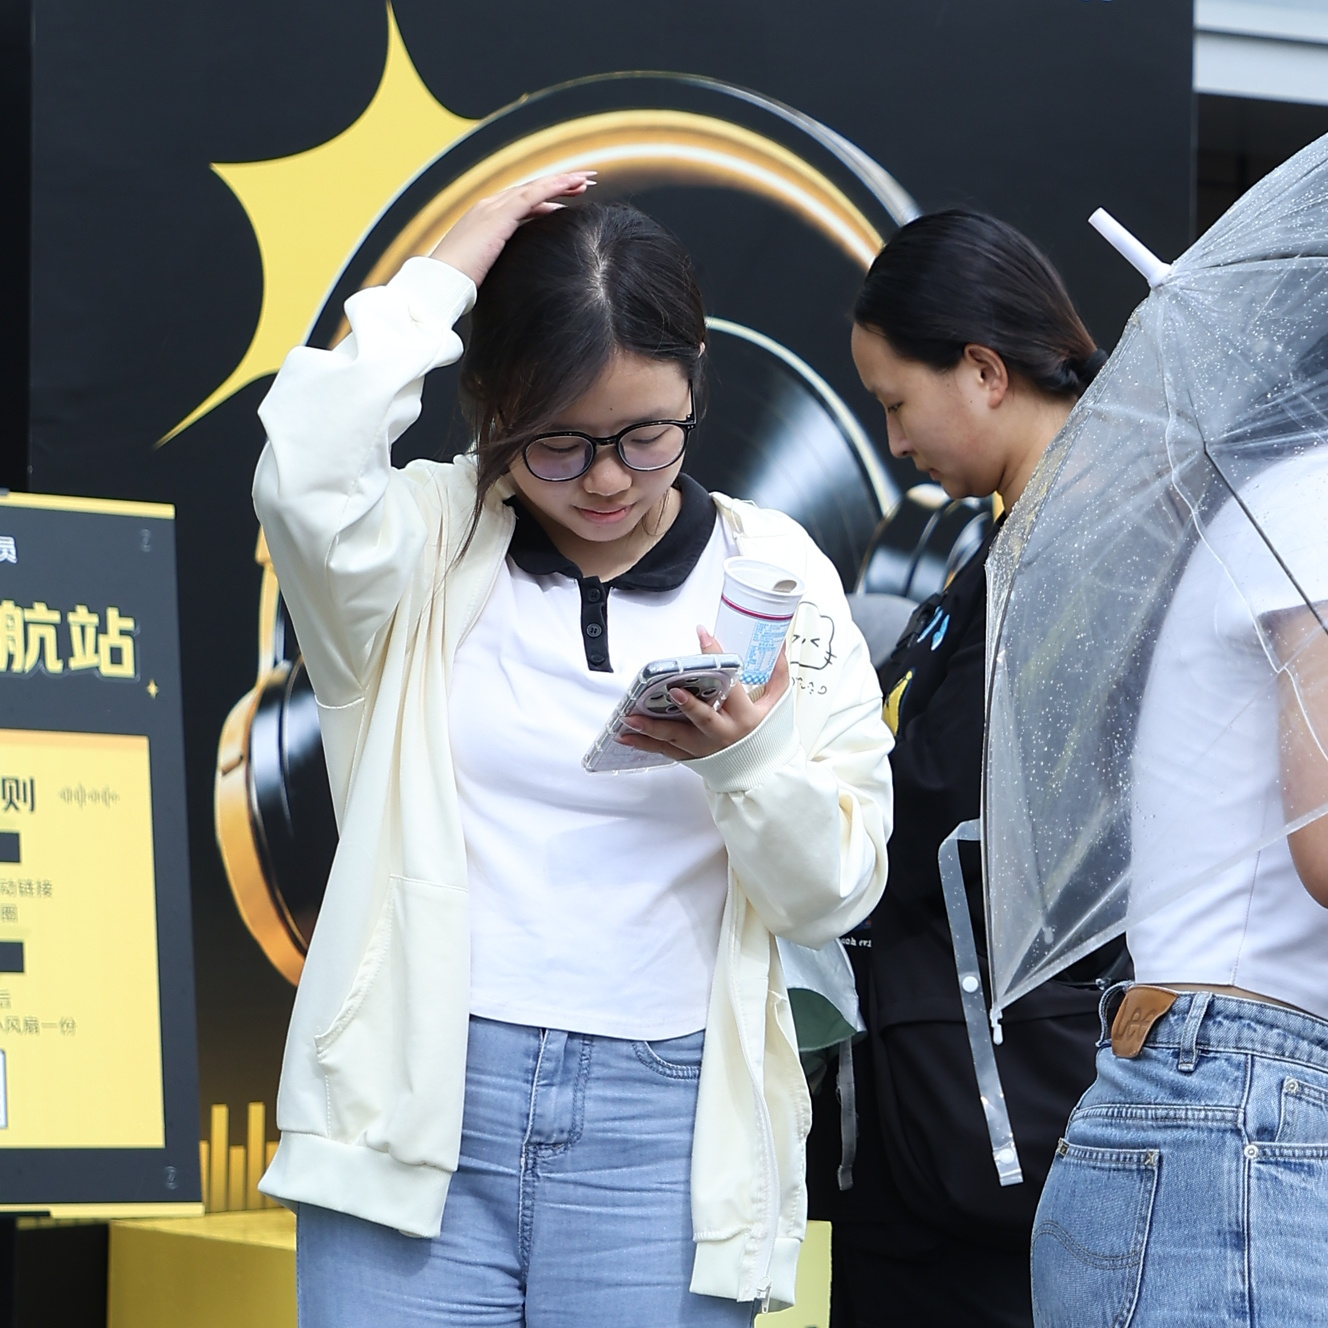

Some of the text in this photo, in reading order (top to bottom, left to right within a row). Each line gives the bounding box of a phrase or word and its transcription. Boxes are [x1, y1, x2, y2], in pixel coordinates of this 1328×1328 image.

[0, 598, 137, 680] 航站
[1, 776, 36, 814] 则
[0, 1015, 77, 1037] 风扇一份
